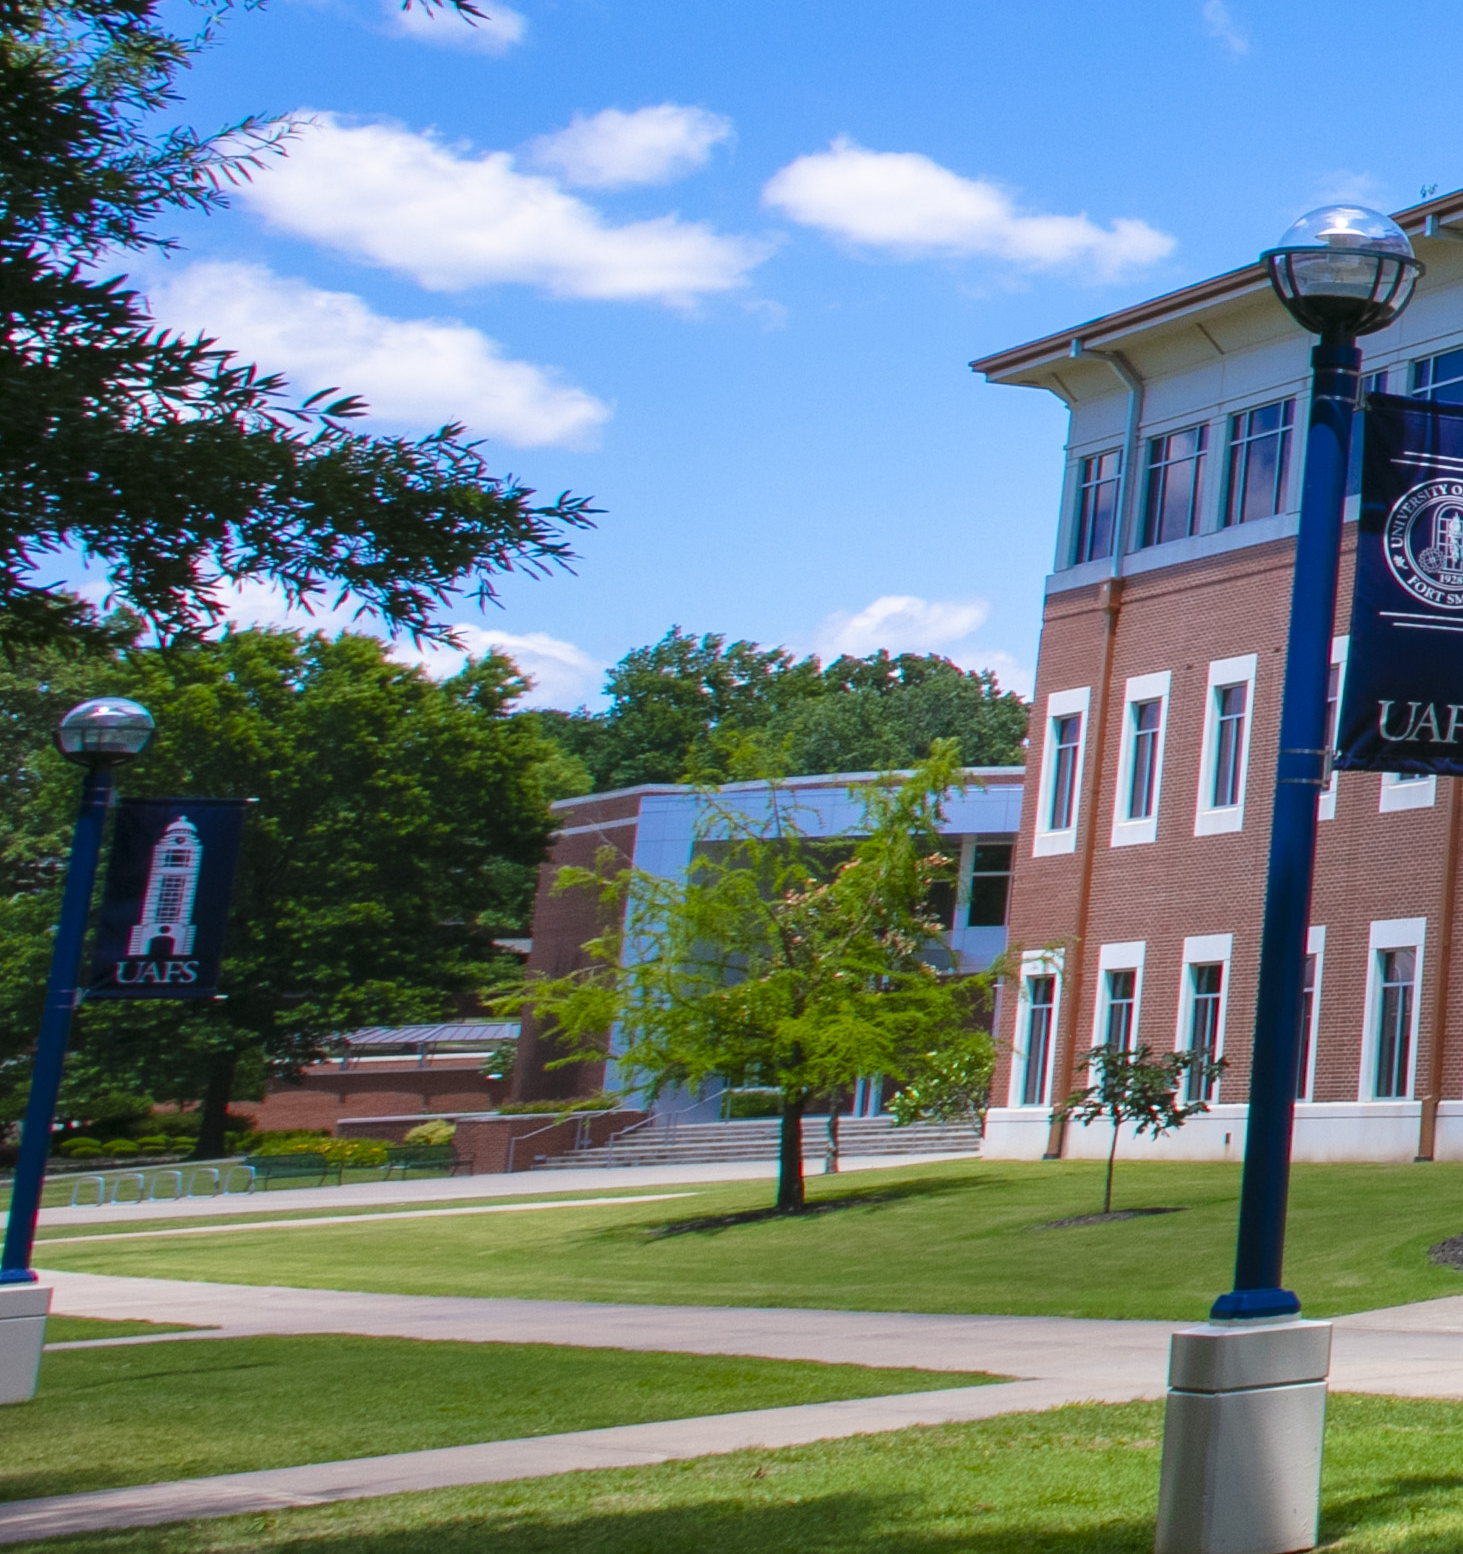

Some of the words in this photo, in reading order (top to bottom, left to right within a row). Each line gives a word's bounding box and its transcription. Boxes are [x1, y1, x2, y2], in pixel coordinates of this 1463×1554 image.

[1390, 483, 1449, 549] UNIVERSITY
[1407, 574, 1446, 603] FORT
[1439, 574, 1463, 585] 1928
[115, 960, 200, 984] UAFS
